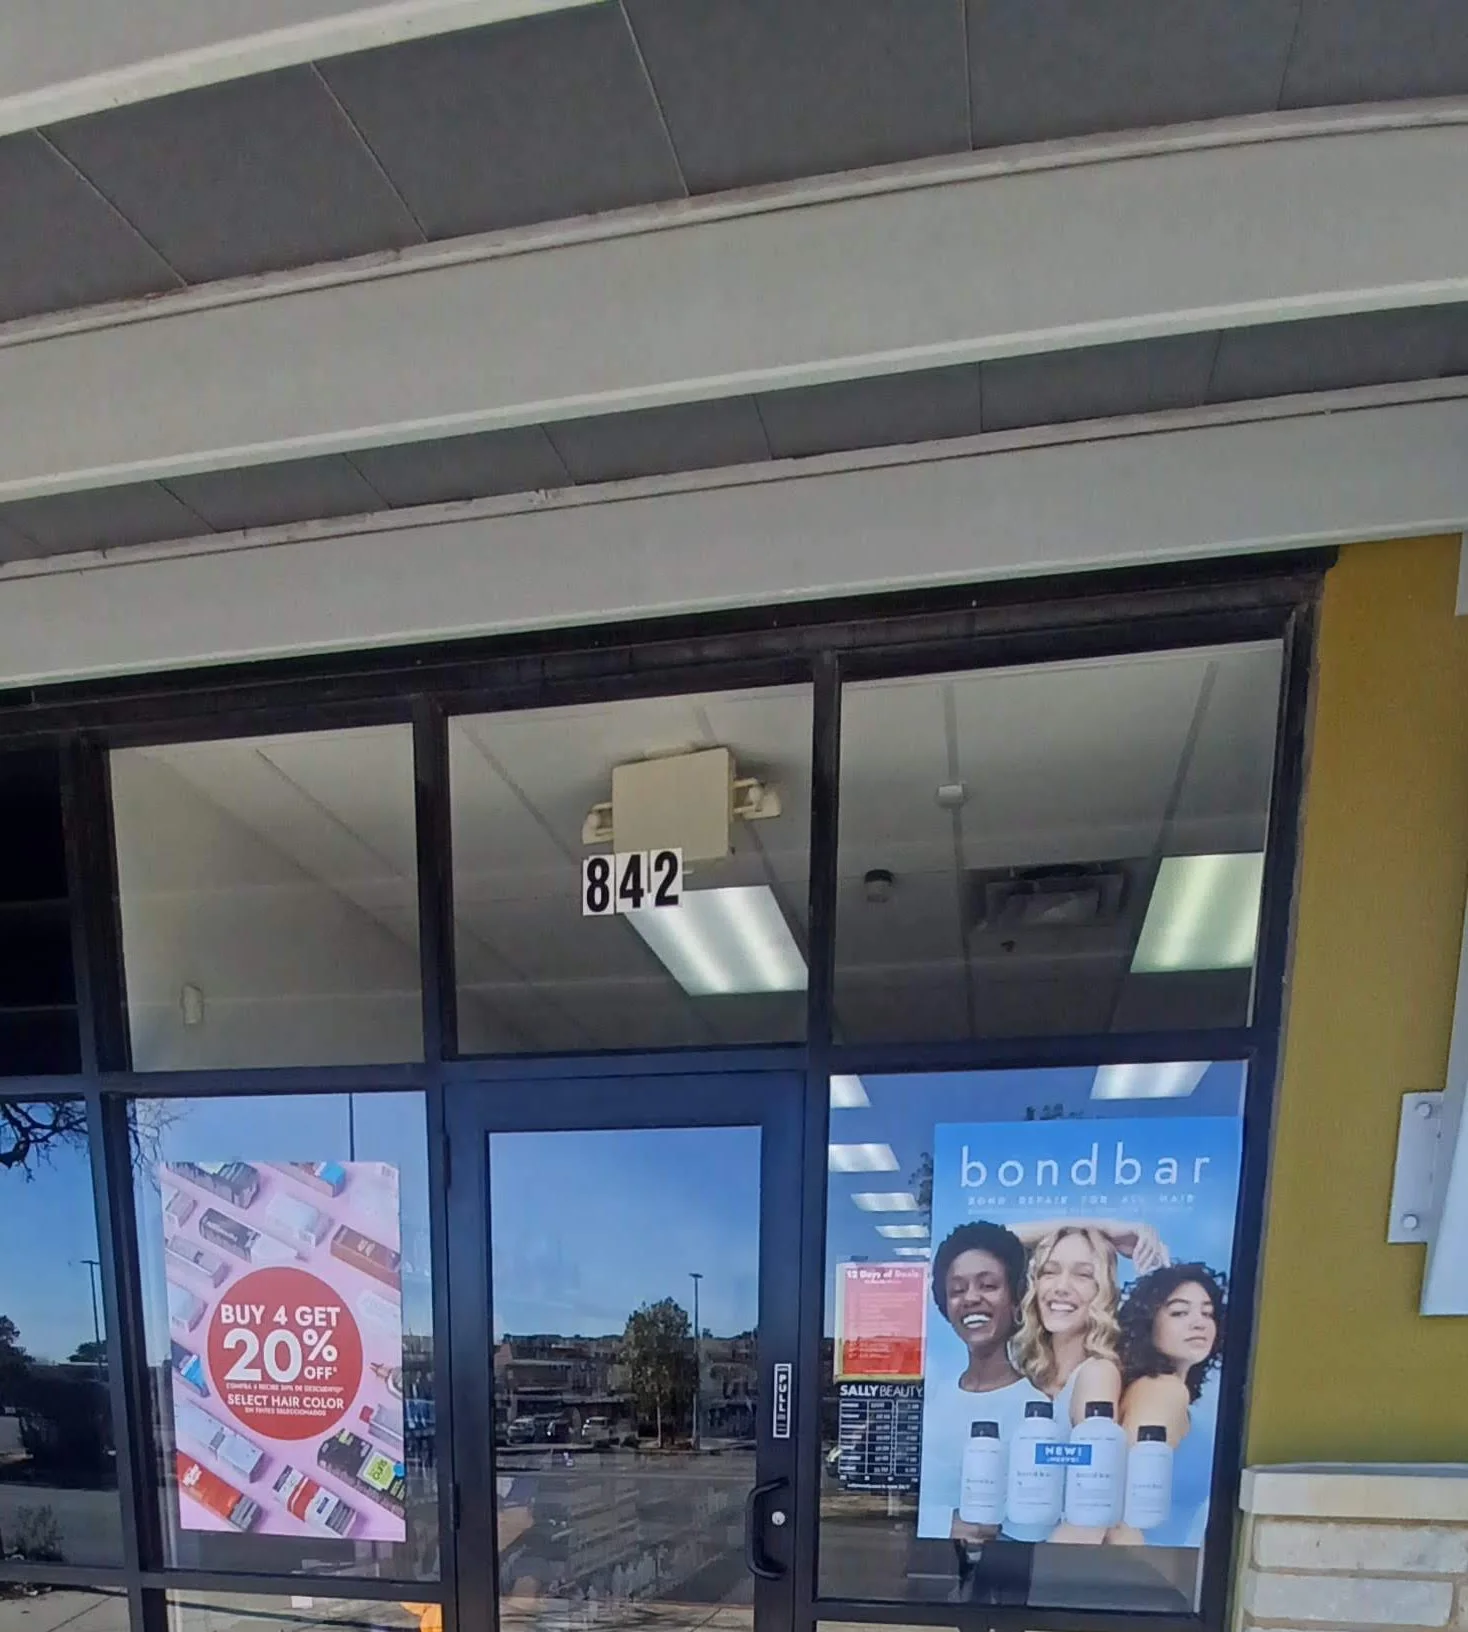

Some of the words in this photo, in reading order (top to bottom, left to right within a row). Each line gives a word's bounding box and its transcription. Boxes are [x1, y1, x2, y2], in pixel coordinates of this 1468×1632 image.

[586, 851, 679, 912] 842
[221, 1304, 265, 1325] BUY
[273, 1305, 288, 1325] 4
[295, 1306, 341, 1327] GET
[223, 1328, 338, 1383] 20%
[228, 1395, 268, 1406] SELECT
[272, 1396, 299, 1407] HAIR
[303, 1397, 344, 1409] COLOR
[779, 1374, 787, 1412] PULL
[1045, 1446, 1082, 1456] NEW!
